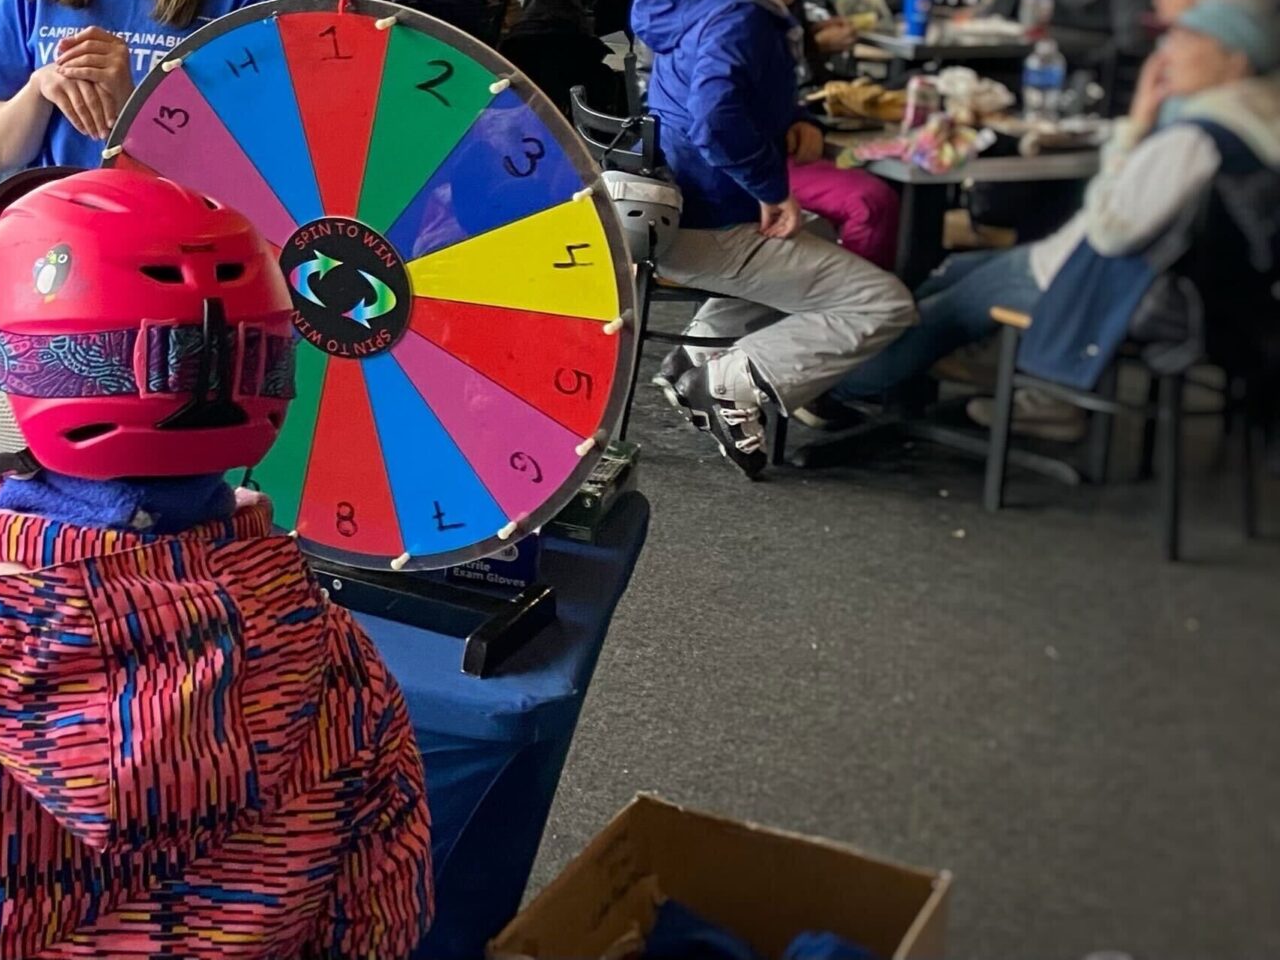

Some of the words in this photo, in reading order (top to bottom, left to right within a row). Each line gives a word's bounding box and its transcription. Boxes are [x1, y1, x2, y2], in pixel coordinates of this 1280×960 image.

[39, 26, 82, 38] CAMPU
[318, 26, 354, 62] 1
[415, 60, 456, 108] 2
[152, 105, 190, 136] 13
[502, 137, 545, 179] 3
[294, 223, 331, 251] SPIN
[336, 222, 358, 238] TO
[363, 232, 397, 268] WIN
[552, 242, 592, 270] 4
[291, 310, 322, 342] WIN
[353, 328, 392, 355] SPIN
[326, 339, 350, 355] TO
[553, 370, 592, 400] 5
[509, 451, 544, 484] 6
[335, 502, 359, 537] 8
[431, 500, 466, 532] 7
[453, 567, 483, 580] Exam
[486, 572, 526, 588] Gloves
[462, 561, 491, 572] trile
